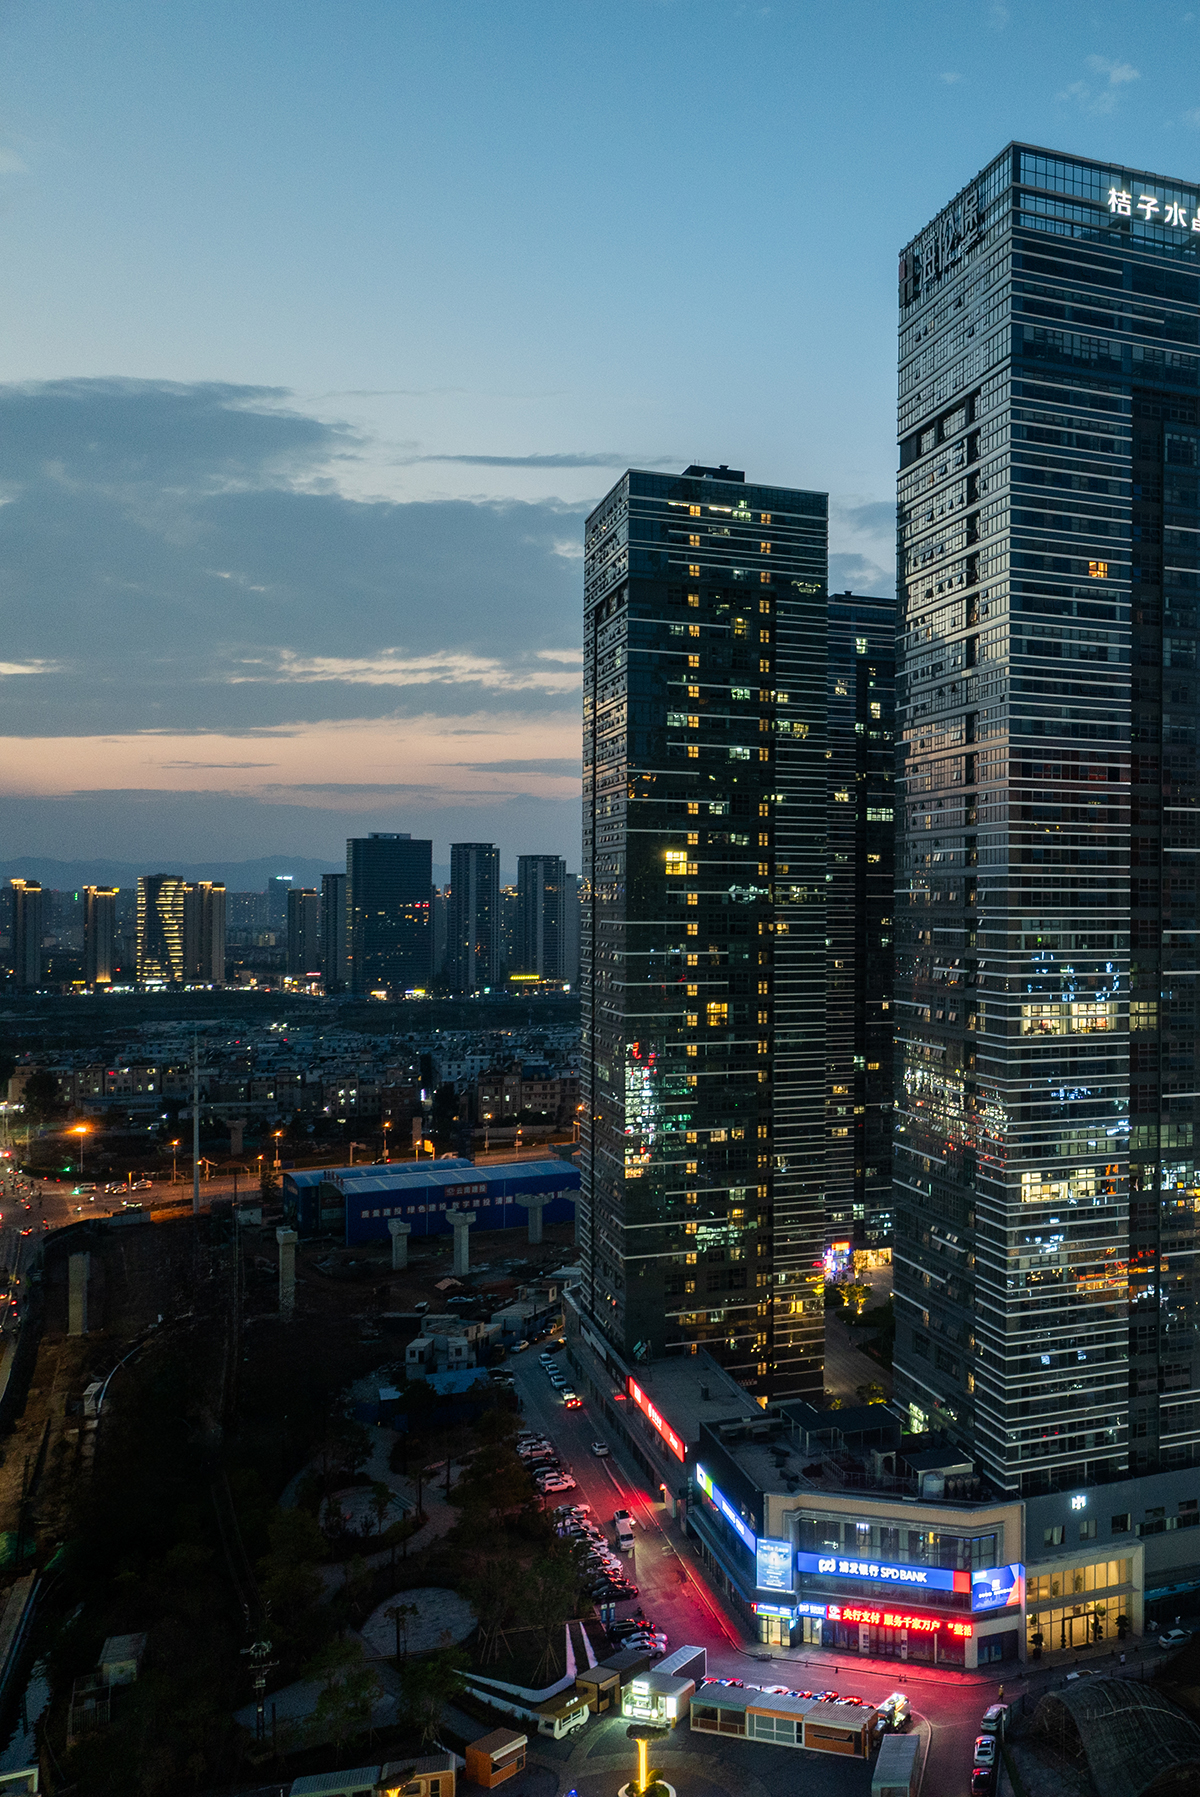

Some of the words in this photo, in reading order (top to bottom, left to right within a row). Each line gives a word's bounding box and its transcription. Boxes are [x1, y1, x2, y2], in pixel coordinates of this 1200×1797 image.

[880, 1566, 900, 1580] SPD
[900, 1569, 927, 1583] BANK
[842, 1608, 880, 1624] 央行支付
